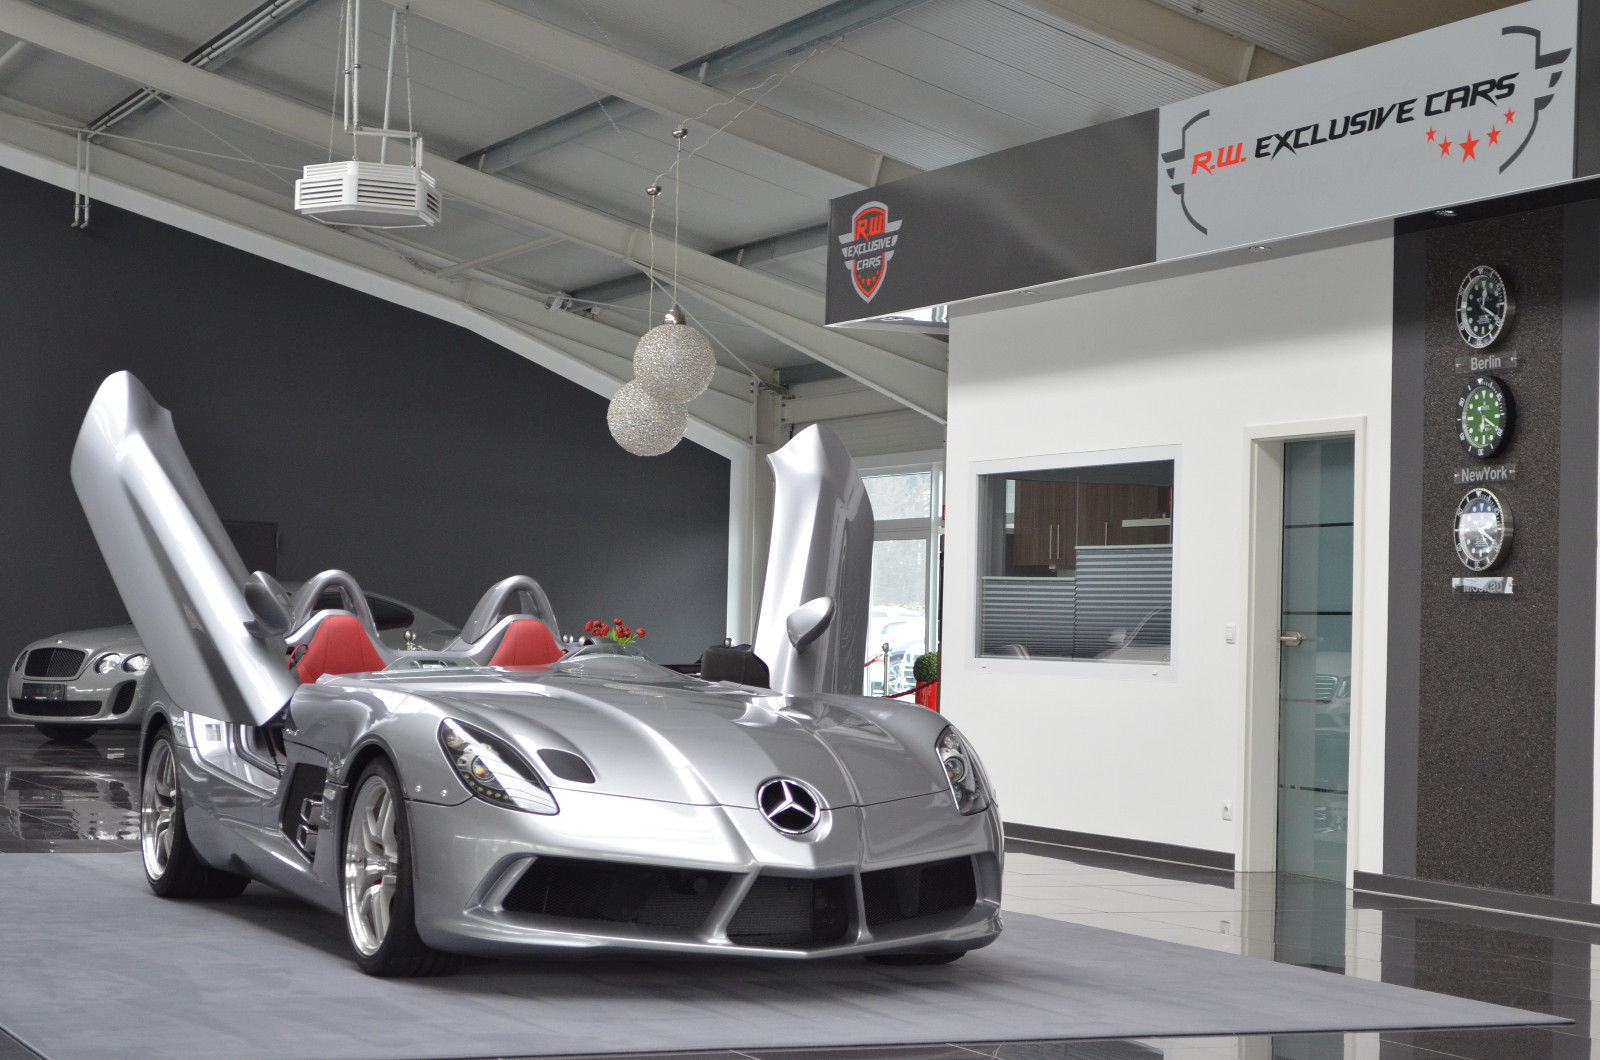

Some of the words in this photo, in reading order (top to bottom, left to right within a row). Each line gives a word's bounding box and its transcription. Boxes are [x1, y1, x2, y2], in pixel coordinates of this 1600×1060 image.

[1191, 142, 1247, 175] R.W.
[1255, 98, 1418, 160] EXCLUSIVE
[1424, 72, 1520, 117] CARS
[848, 236, 892, 257] EXCLUSIVE
[856, 256, 882, 270] CARS
[1470, 355, 1501, 370] Berlin
[1461, 465, 1507, 482] NewYork
